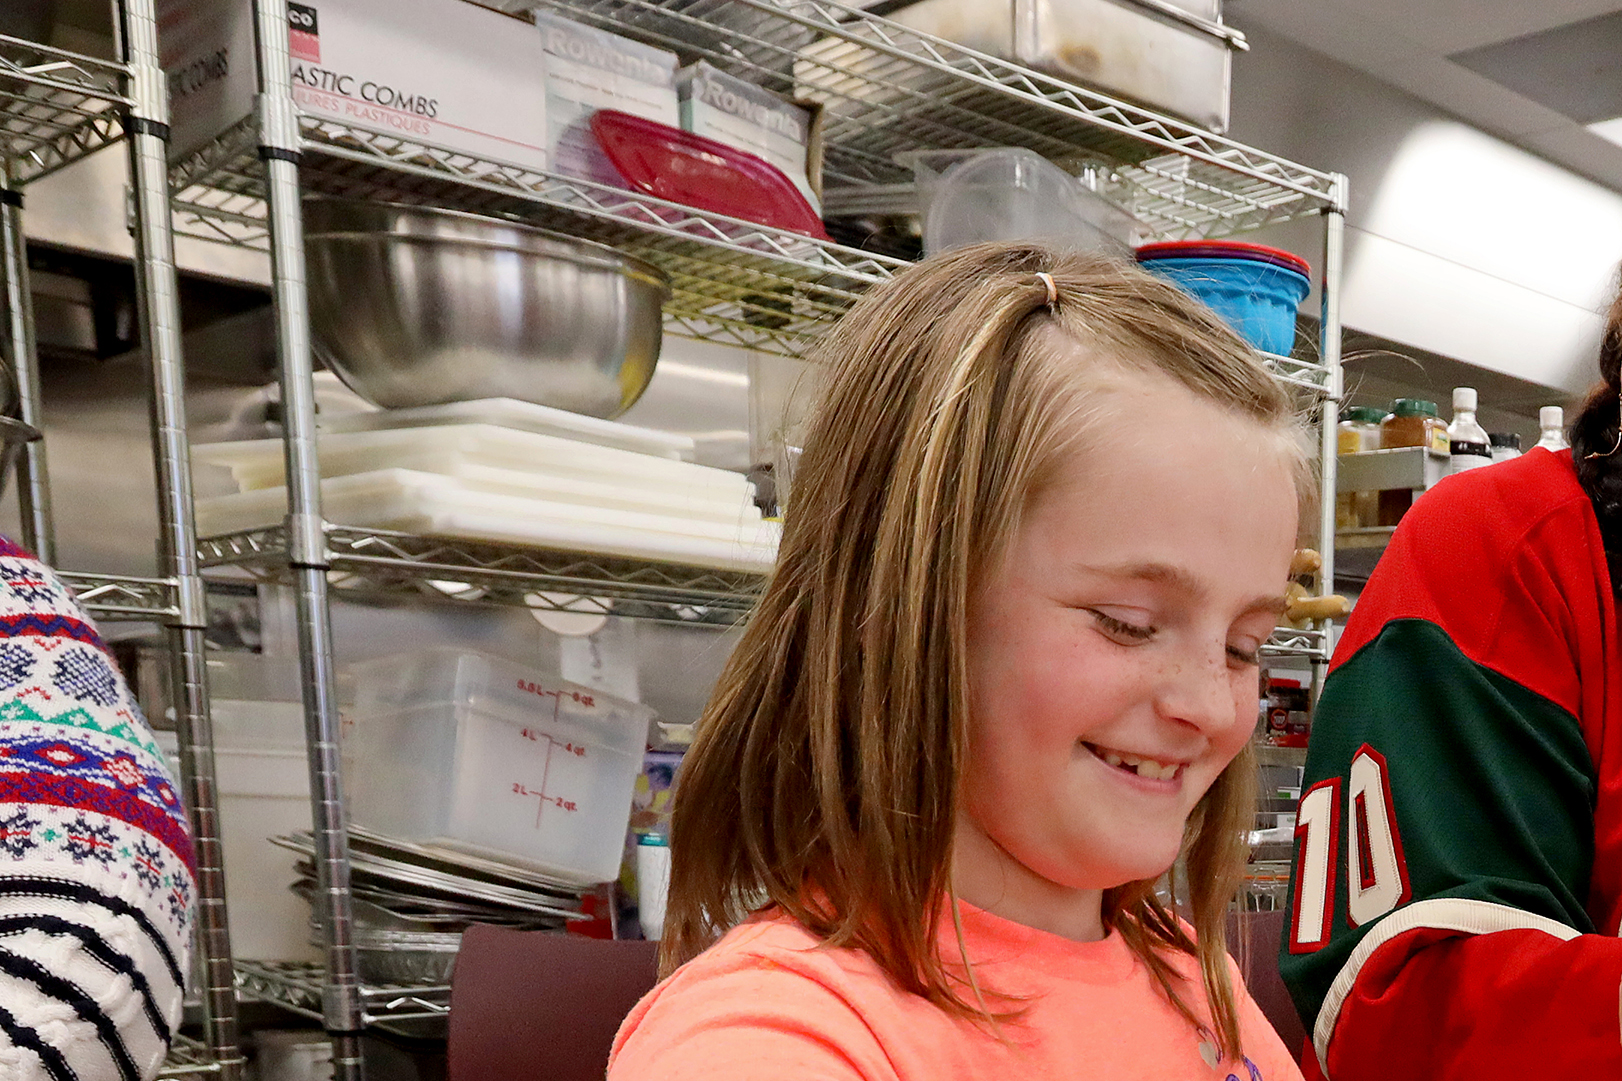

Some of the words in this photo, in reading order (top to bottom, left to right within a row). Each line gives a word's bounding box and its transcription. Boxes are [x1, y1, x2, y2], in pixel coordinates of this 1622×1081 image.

[291, 64, 354, 96] ASTIC
[361, 82, 439, 118] COMBS
[345, 102, 430, 135] PLASTIQUES
[1292, 745, 1410, 952] 10
